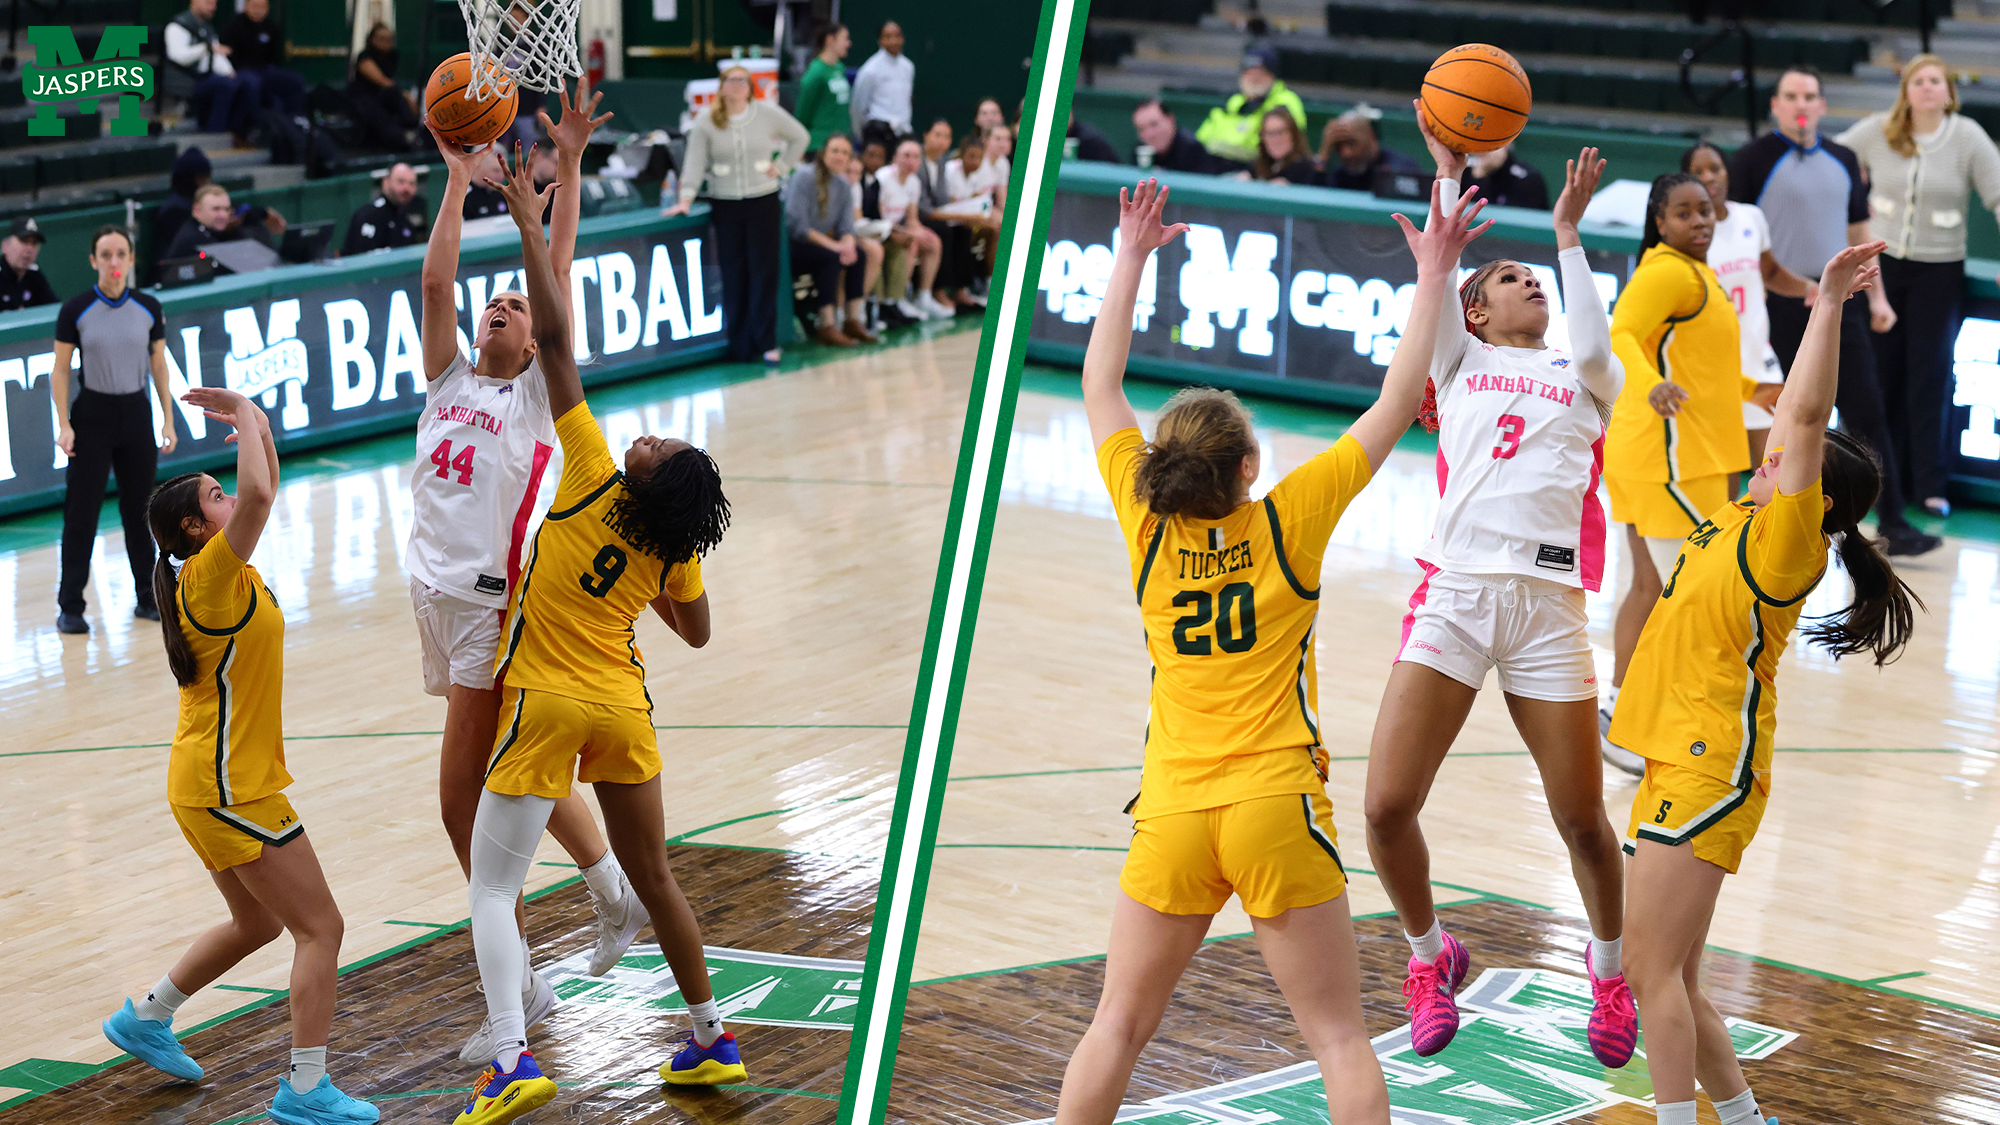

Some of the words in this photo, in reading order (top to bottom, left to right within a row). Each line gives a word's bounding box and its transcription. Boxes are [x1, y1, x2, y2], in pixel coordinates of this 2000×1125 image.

[1466, 374, 1575, 408] MANHATTAN
[1491, 413, 1526, 460] 3
[430, 438, 476, 486] 44
[579, 544, 628, 598] 9
[1178, 540, 1253, 579] TUCKER
[1172, 582, 1257, 655] 20
[1654, 798, 1673, 824] S
